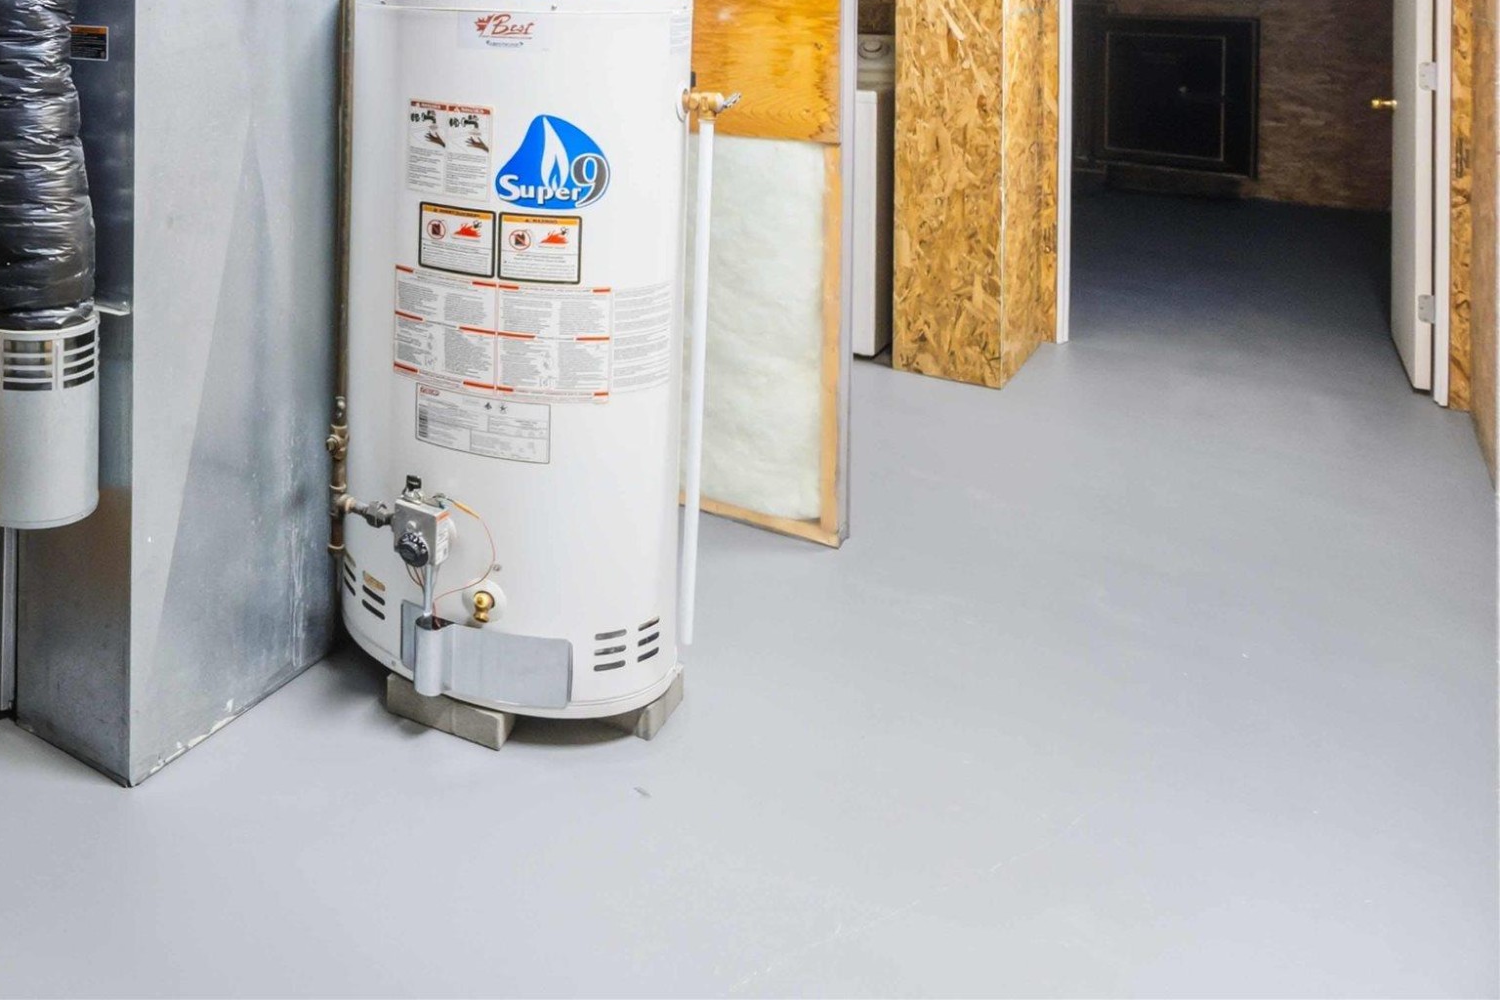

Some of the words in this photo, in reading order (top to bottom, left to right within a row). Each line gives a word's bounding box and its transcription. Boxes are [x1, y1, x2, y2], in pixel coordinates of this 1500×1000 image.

[491, 13, 534, 35] Best
[499, 174, 582, 205] Super
[571, 152, 609, 209] 9
